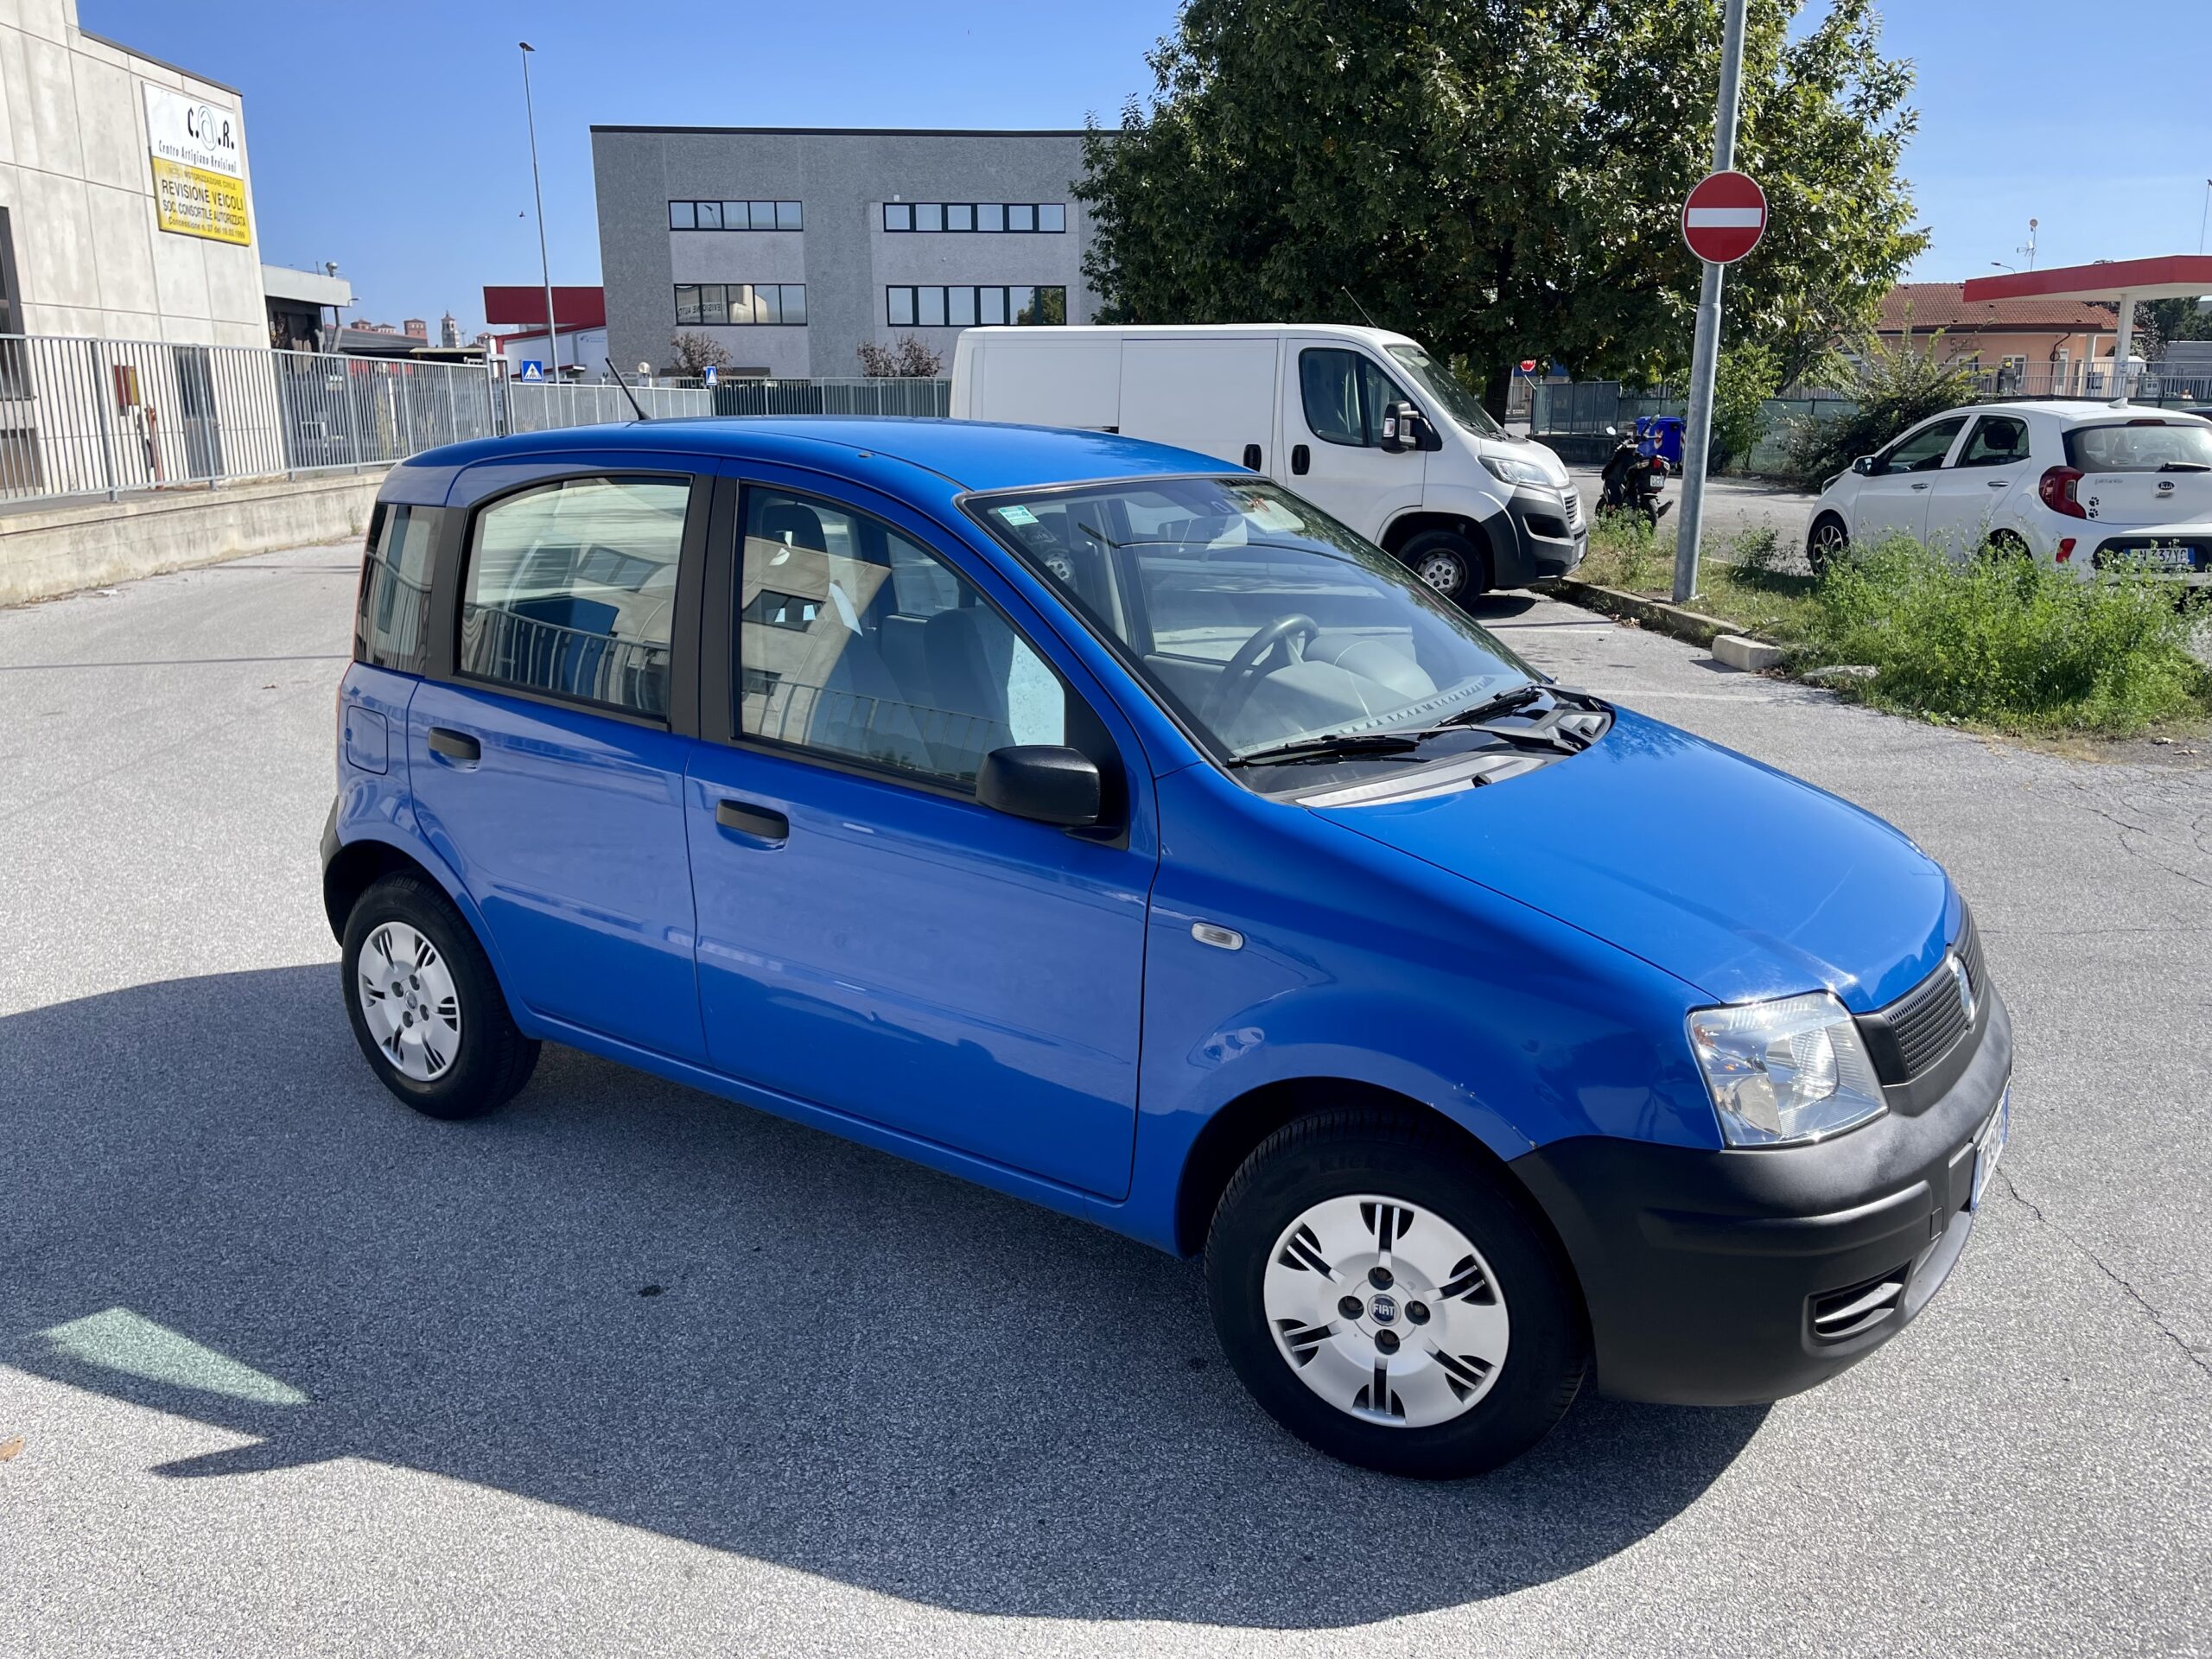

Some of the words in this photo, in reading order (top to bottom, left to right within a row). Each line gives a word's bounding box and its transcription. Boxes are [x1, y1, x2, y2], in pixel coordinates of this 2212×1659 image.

[159, 140, 179, 156] Centro
[181, 146, 209, 165] Artigiano
[162, 179, 210, 204] REVISIONE
[212, 191, 244, 211] VEICOLI
[178, 202, 213, 221] CONSORTILE
[213, 211, 246, 227] AUTORIZZATA
[1374, 1303, 1395, 1316] FIAT
